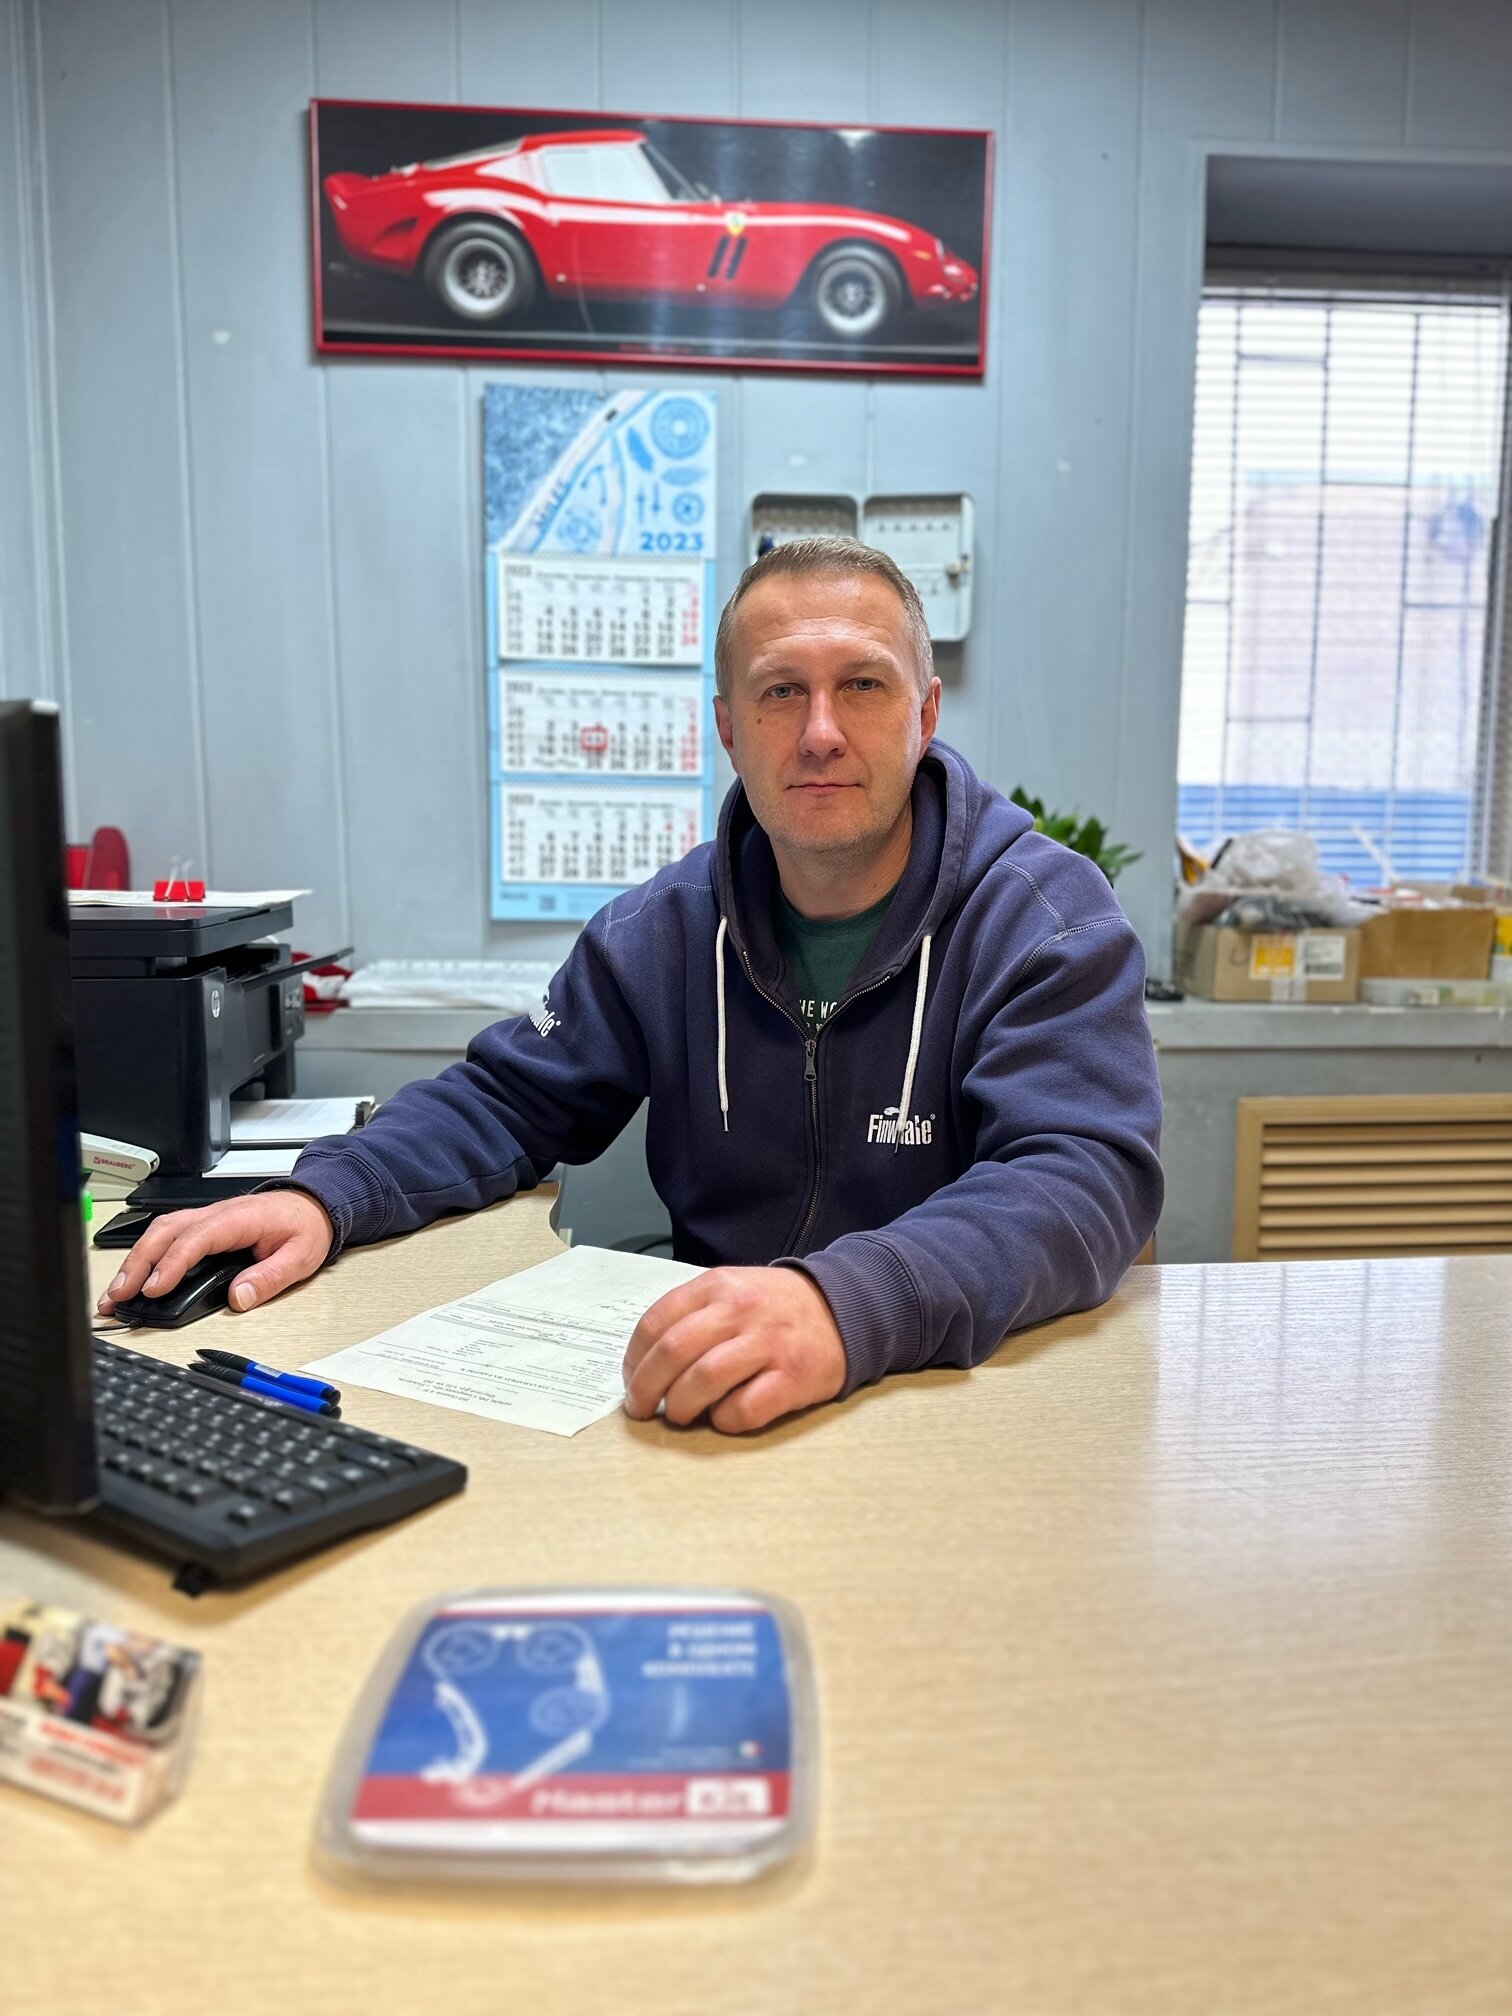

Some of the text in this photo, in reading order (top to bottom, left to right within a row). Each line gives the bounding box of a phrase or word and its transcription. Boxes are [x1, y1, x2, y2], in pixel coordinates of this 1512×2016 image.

[640, 532, 704, 551] 2023
[867, 1114, 932, 1145] Finwale
[100, 1159, 132, 1169] BRAUBERG
